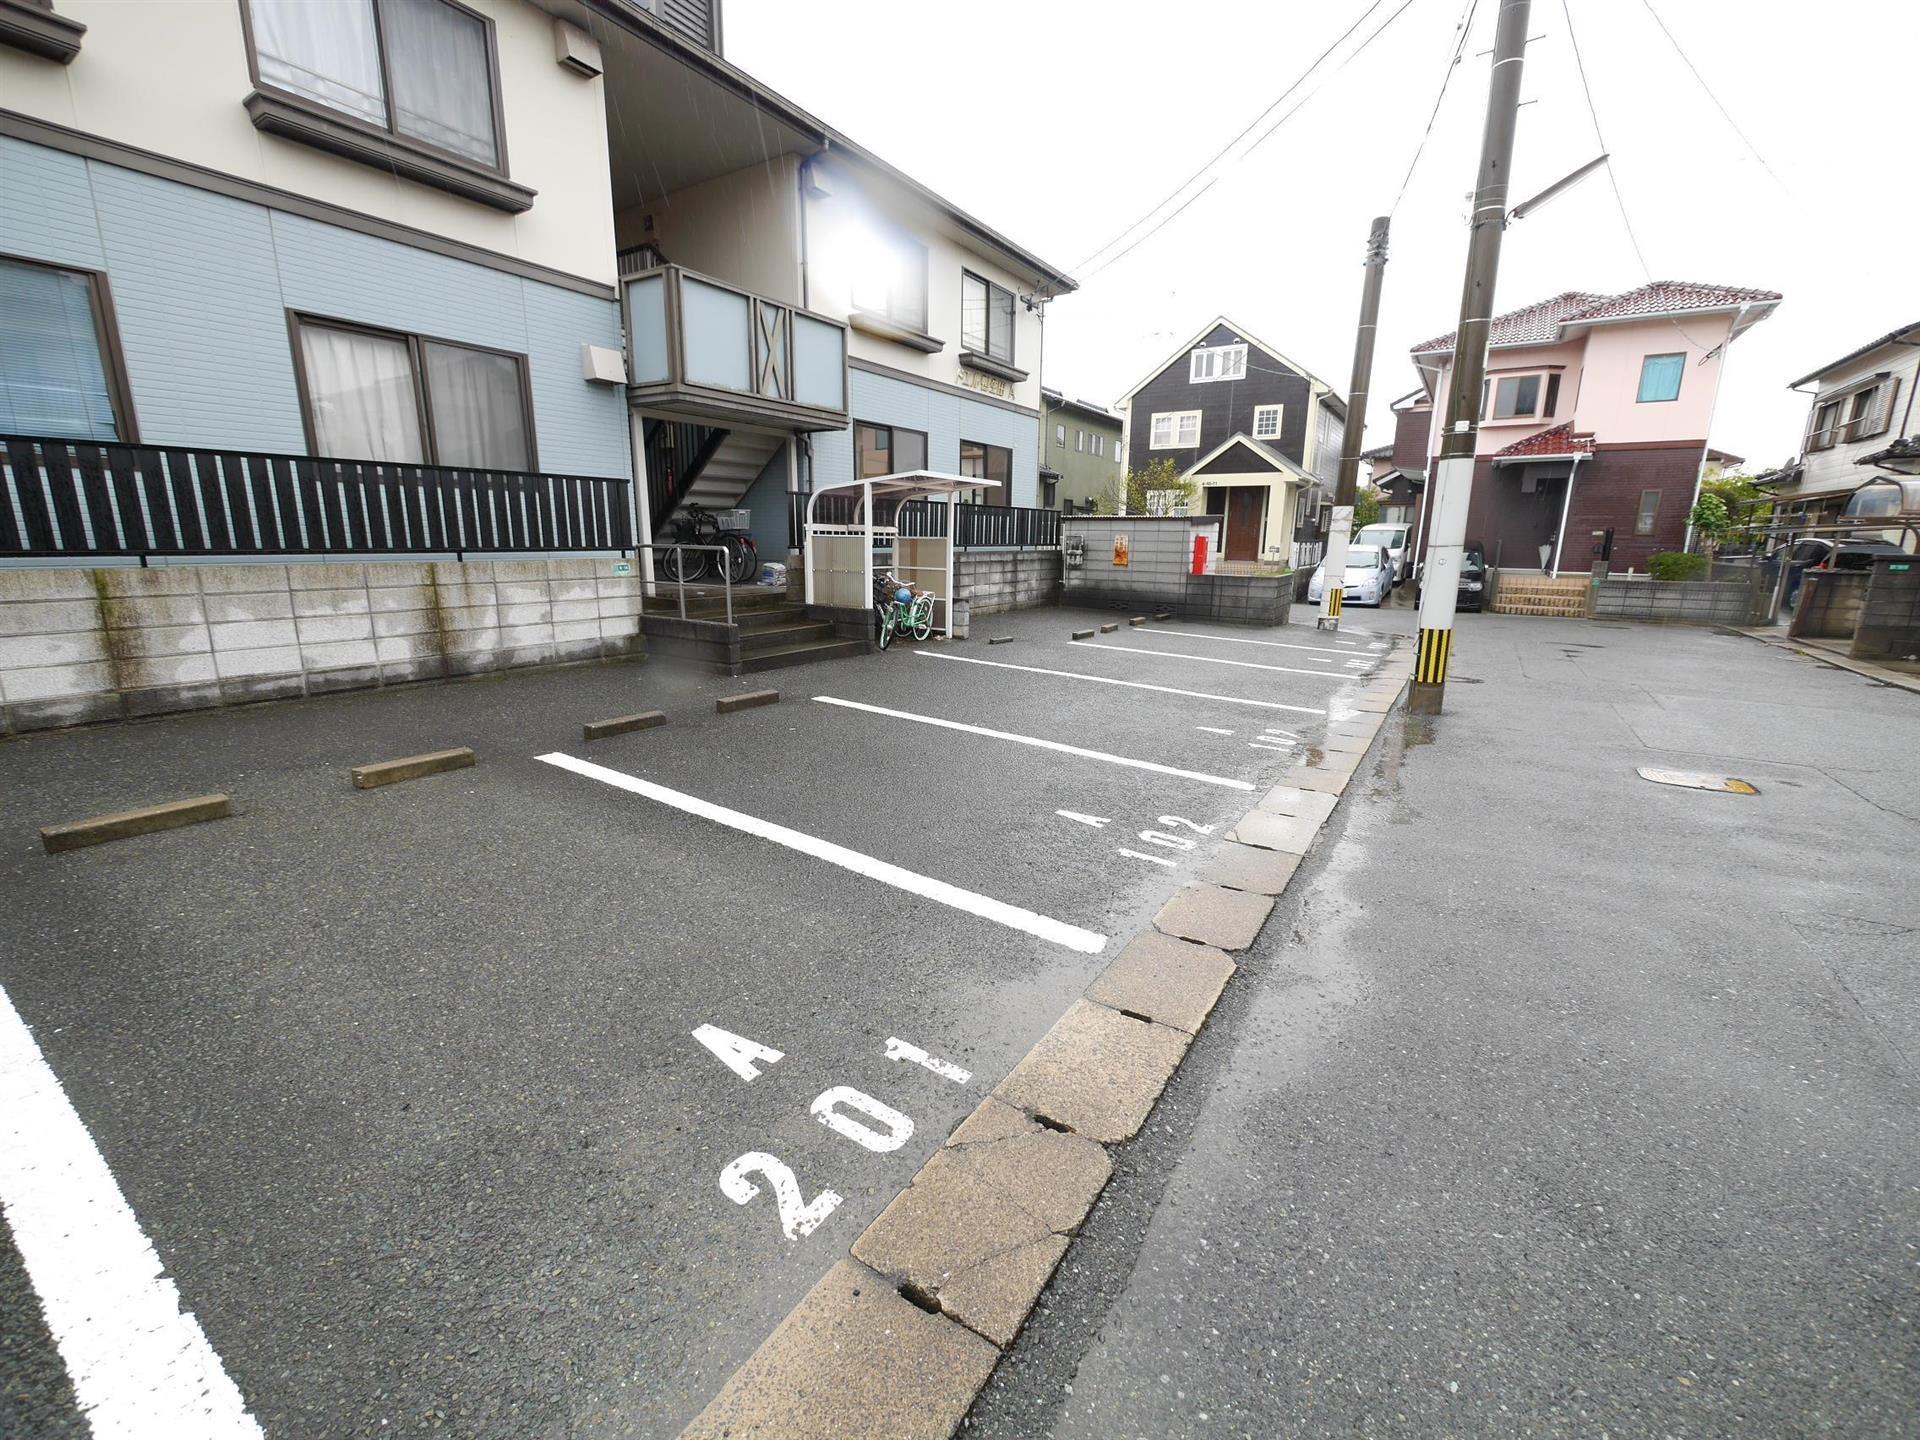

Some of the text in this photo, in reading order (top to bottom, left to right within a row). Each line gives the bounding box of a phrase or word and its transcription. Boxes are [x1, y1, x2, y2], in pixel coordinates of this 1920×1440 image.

[1195, 726, 1235, 736] A
[1054, 808, 1113, 829] A
[1117, 814, 1215, 868] 102
[690, 1023, 786, 1083] A
[718, 1036, 974, 1241] 201
